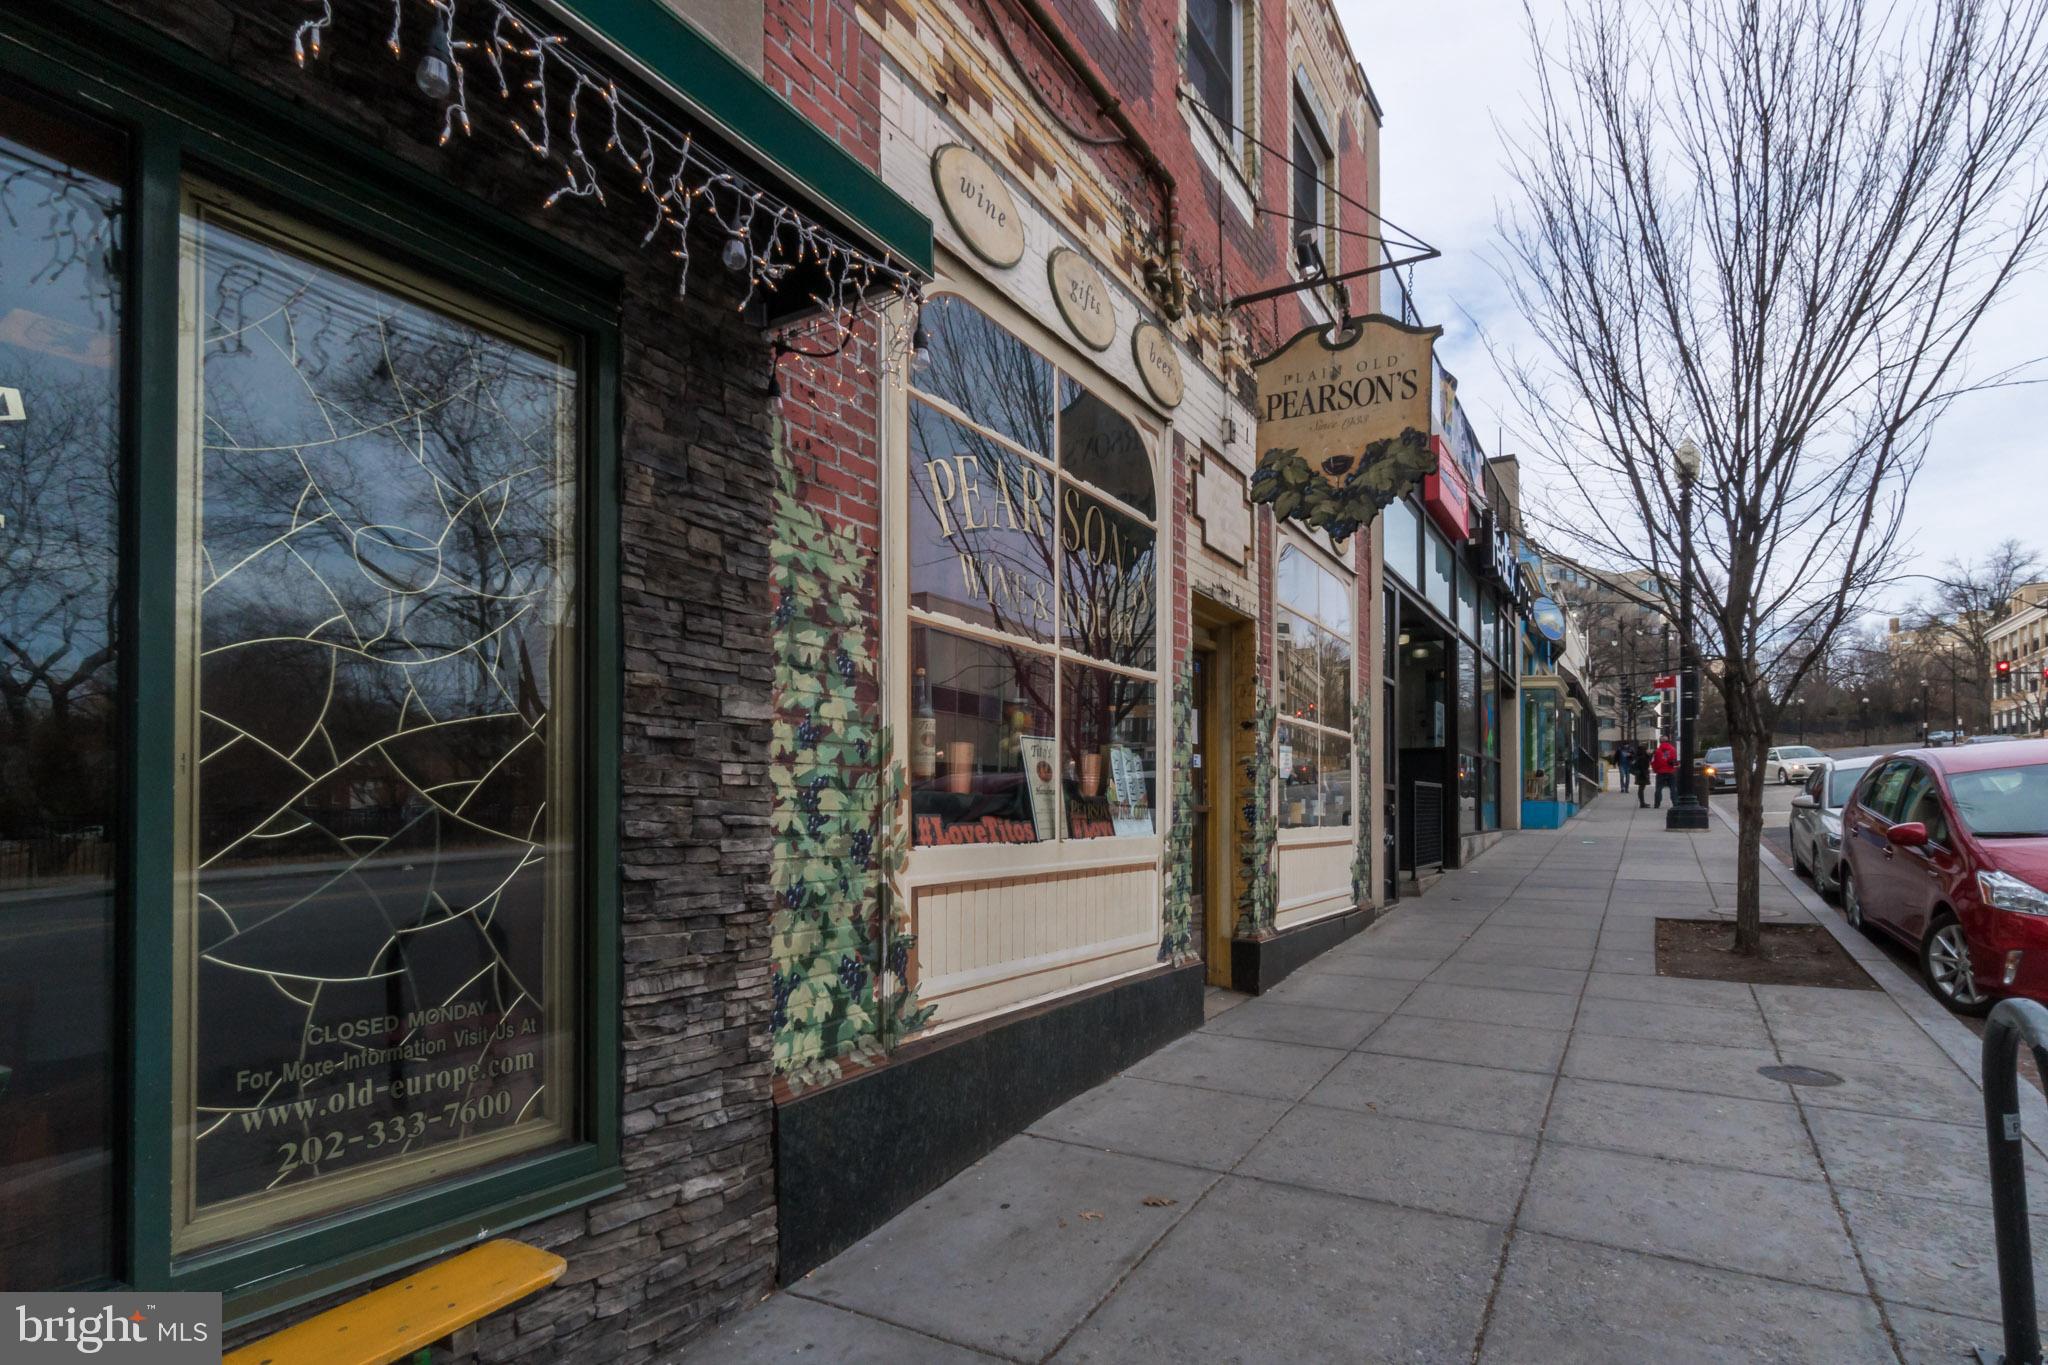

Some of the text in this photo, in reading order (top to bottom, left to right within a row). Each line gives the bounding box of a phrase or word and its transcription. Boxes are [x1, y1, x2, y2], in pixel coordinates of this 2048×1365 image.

[960, 175, 1007, 228] wine
[1070, 278, 1101, 315] gifts
[1149, 343, 1174, 377] beer
[1283, 355, 1399, 386] PLAIN OLD
[1266, 369, 1418, 422] PEARSON'S
[917, 815, 1035, 846] #LoveTitos
[307, 1001, 488, 1046] CLOSED MONDAY
[236, 1017, 537, 1093] For More Information Visit Us At
[240, 1051, 535, 1134] www.old-europe.com
[277, 1090, 513, 1173] 202-333-7600
